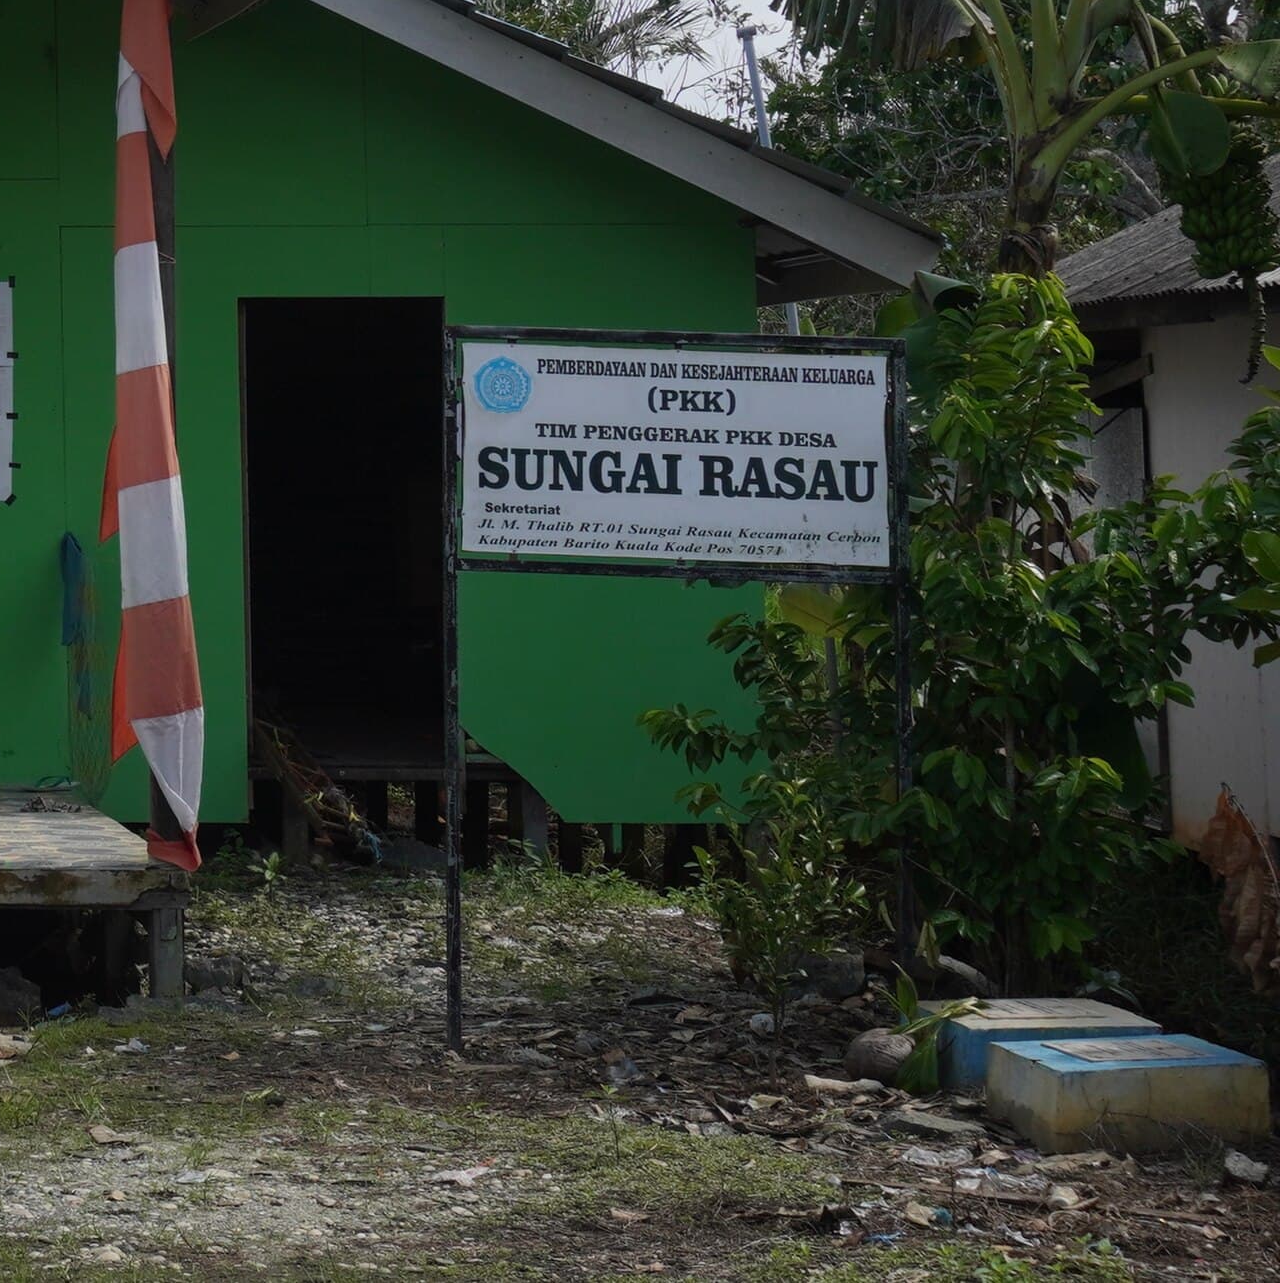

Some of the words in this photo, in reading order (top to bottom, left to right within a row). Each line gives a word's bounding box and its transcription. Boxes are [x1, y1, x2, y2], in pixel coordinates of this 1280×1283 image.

[537, 359, 646, 378] PEMBERDAYAAN
[650, 362, 678, 379] DAN
[682, 364, 798, 383] KESEJAHTERAAN
[802, 368, 875, 385] KELUARGA
[647, 386, 736, 416] (PKK)
[535, 423, 577, 438] TIM
[583, 425, 720, 443] PENGGERAK
[726, 430, 773, 445] PKK
[779, 432, 837, 448] DESA
[478, 446, 682, 495] SUNGAI
[699, 455, 878, 503] RASAU
[485, 502, 560, 515] Sekretariat
[478, 519, 495, 529] Jl.
[501, 520, 520, 530] M.
[527, 520, 574, 532] Thalib
[580, 523, 623, 534] RT.01
[628, 523, 683, 539] Sungai
[687, 526, 733, 538] Rasau
[739, 528, 821, 541] Kecamatan
[827, 531, 881, 543] Cerbon
[479, 535, 558, 548] Kabupaten
[564, 538, 610, 550] Barito
[615, 540, 659, 552] Kuala
[664, 542, 702, 553] Kode
[707, 544, 733, 555] Pos
